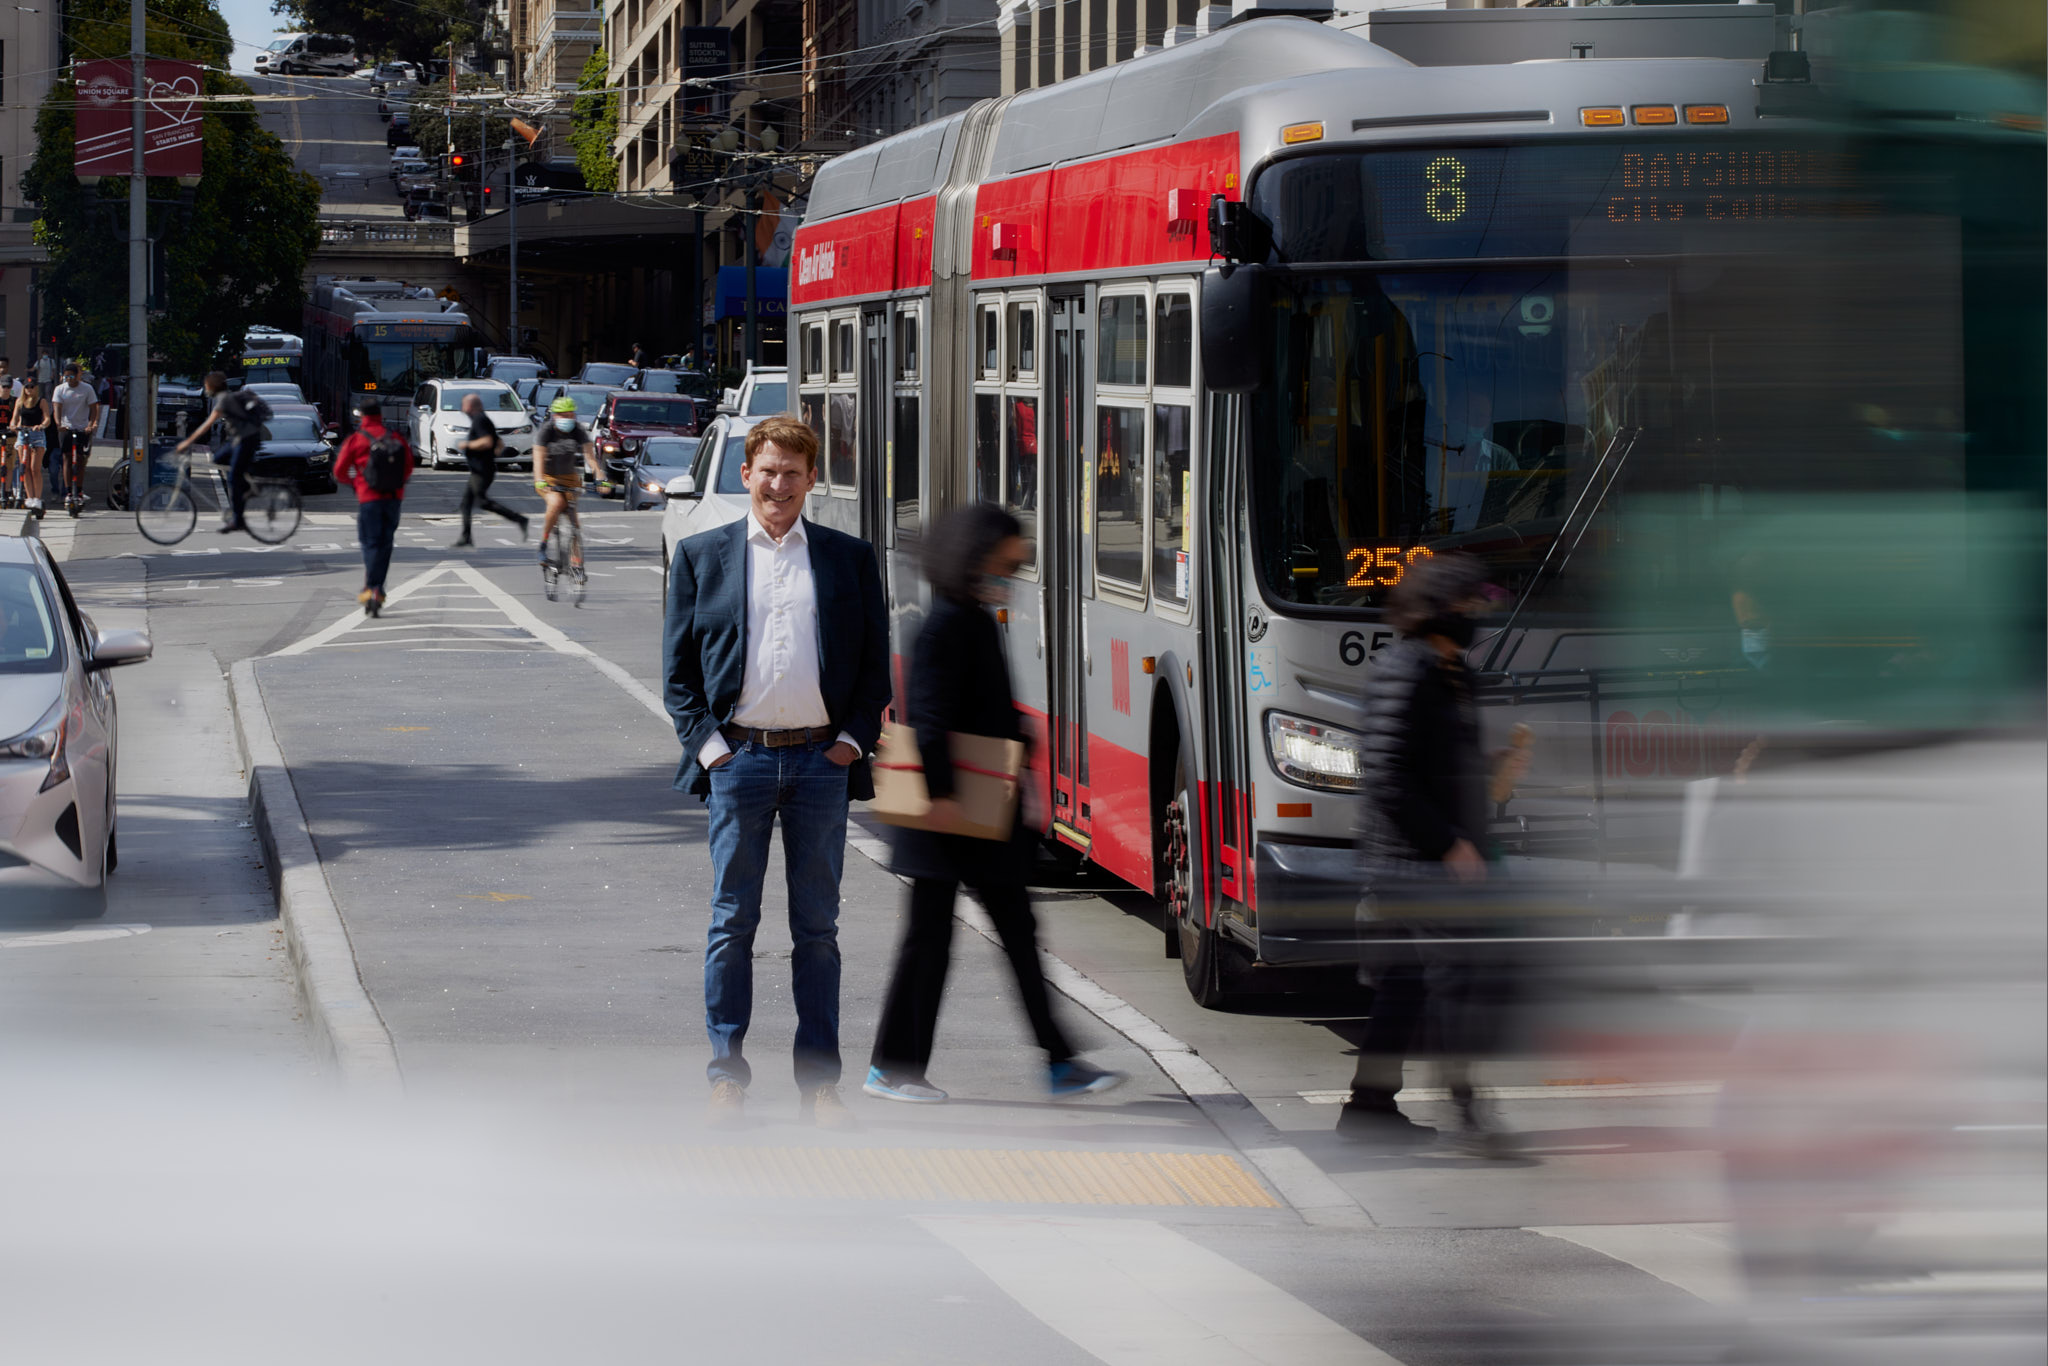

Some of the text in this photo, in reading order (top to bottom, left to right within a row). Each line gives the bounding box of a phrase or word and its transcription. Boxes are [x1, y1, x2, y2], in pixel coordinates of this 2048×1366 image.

[689, 41, 717, 49] SUTTER
[688, 49, 727, 57] STOCKTON
[688, 56, 718, 64] GARAGE
[102, 88, 129, 96] SQUARE
[152, 125, 196, 141] SAN FRANCISCO
[155, 131, 195, 146] STARTS HERE
[1426, 156, 1466, 222] 8
[1607, 196, 1686, 222] City
[765, 300, 788, 313] CA
[374, 325, 388, 337] 15
[242, 356, 291, 366] DROP OFF ONLY
[364, 382, 378, 391] 115
